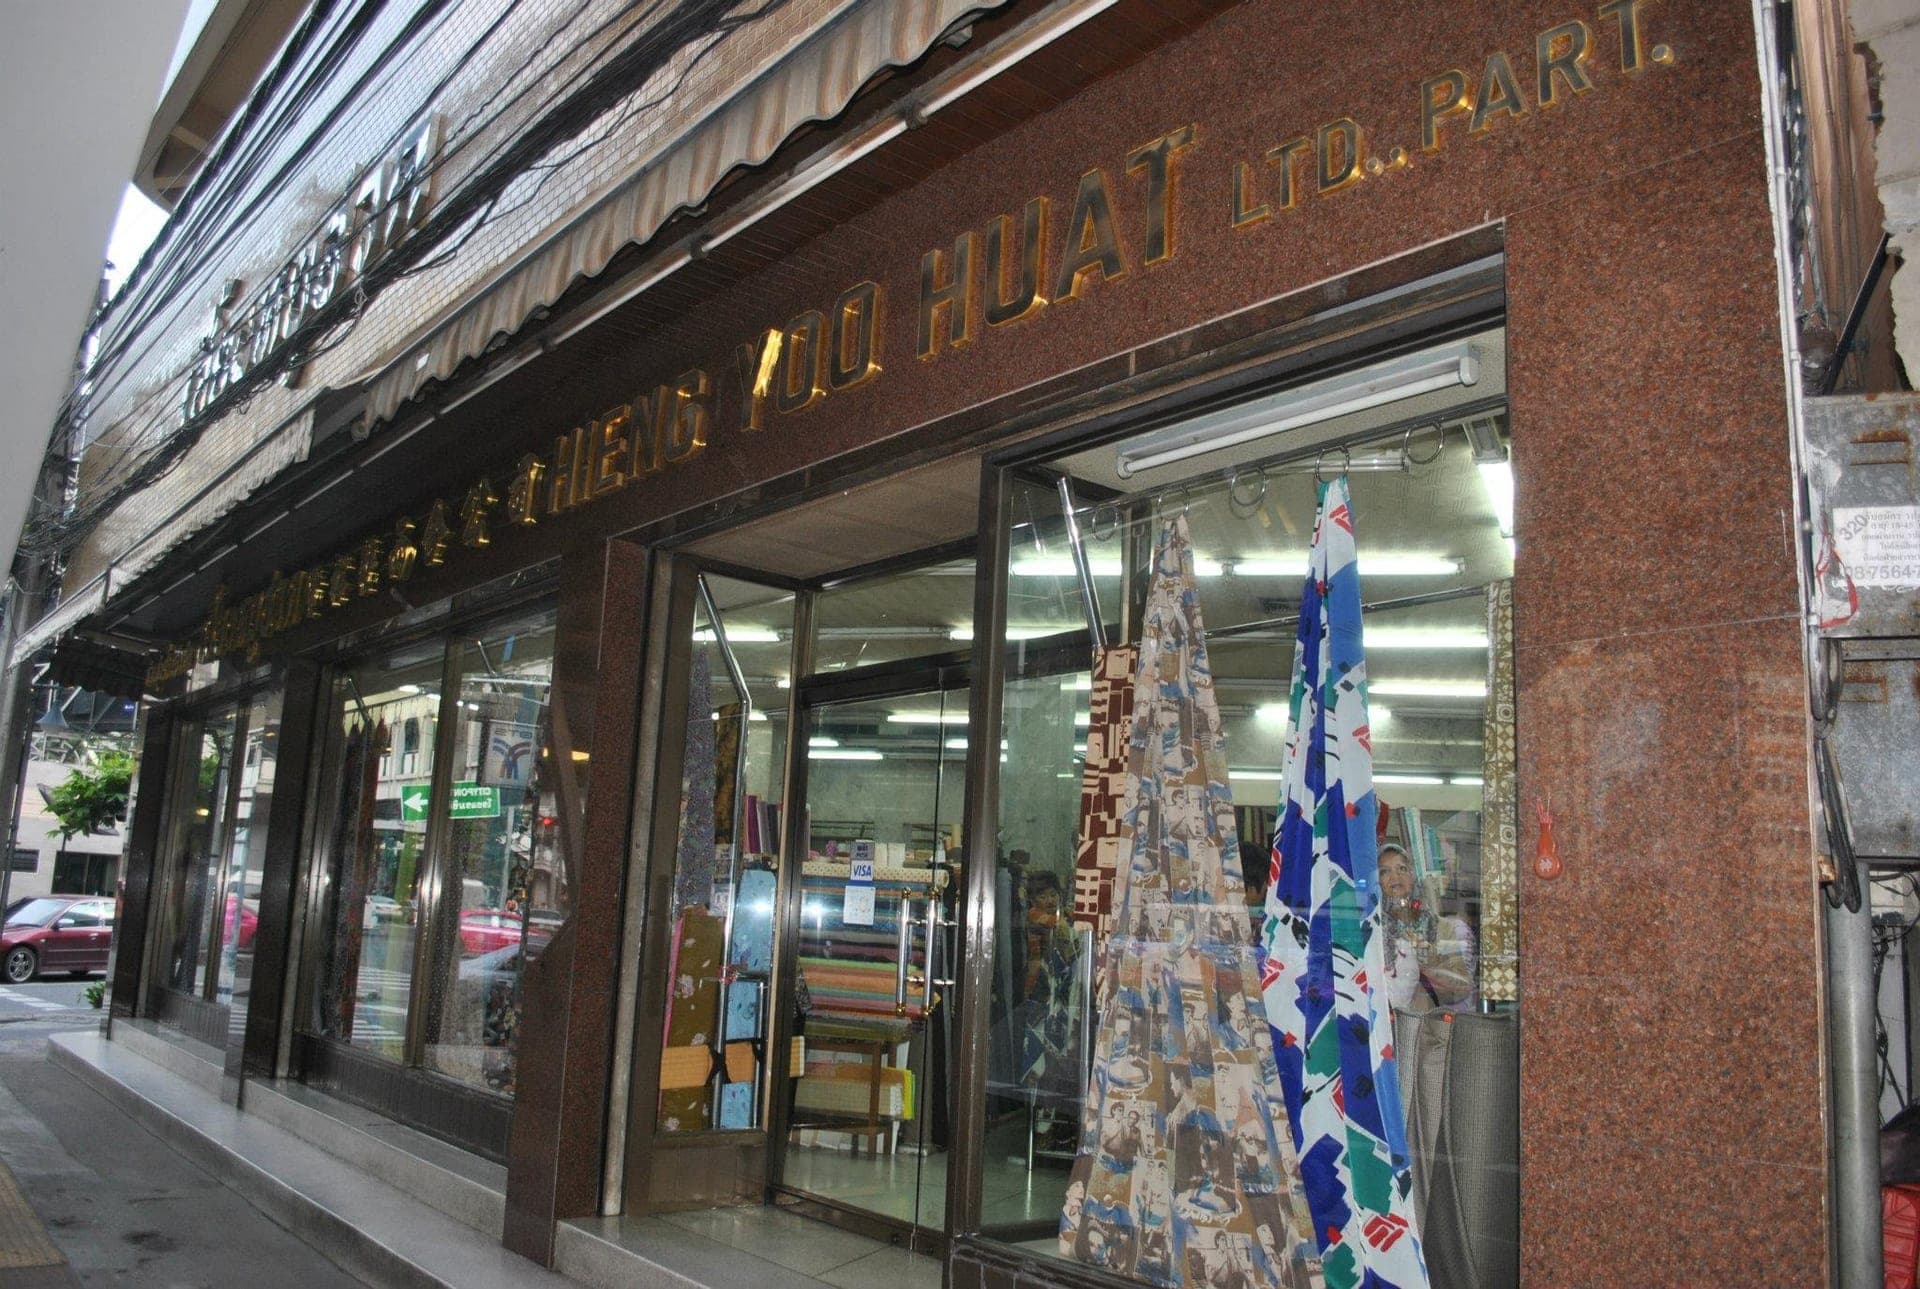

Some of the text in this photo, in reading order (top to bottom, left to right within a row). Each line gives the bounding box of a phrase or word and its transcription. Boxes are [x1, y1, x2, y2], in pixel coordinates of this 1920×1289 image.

[548, 368, 711, 514] HIENG
[736, 280, 883, 431] YOO
[916, 122, 1199, 362] HUAT
[1421, 0, 1675, 152] PART.
[853, 865, 872, 877] VISA
